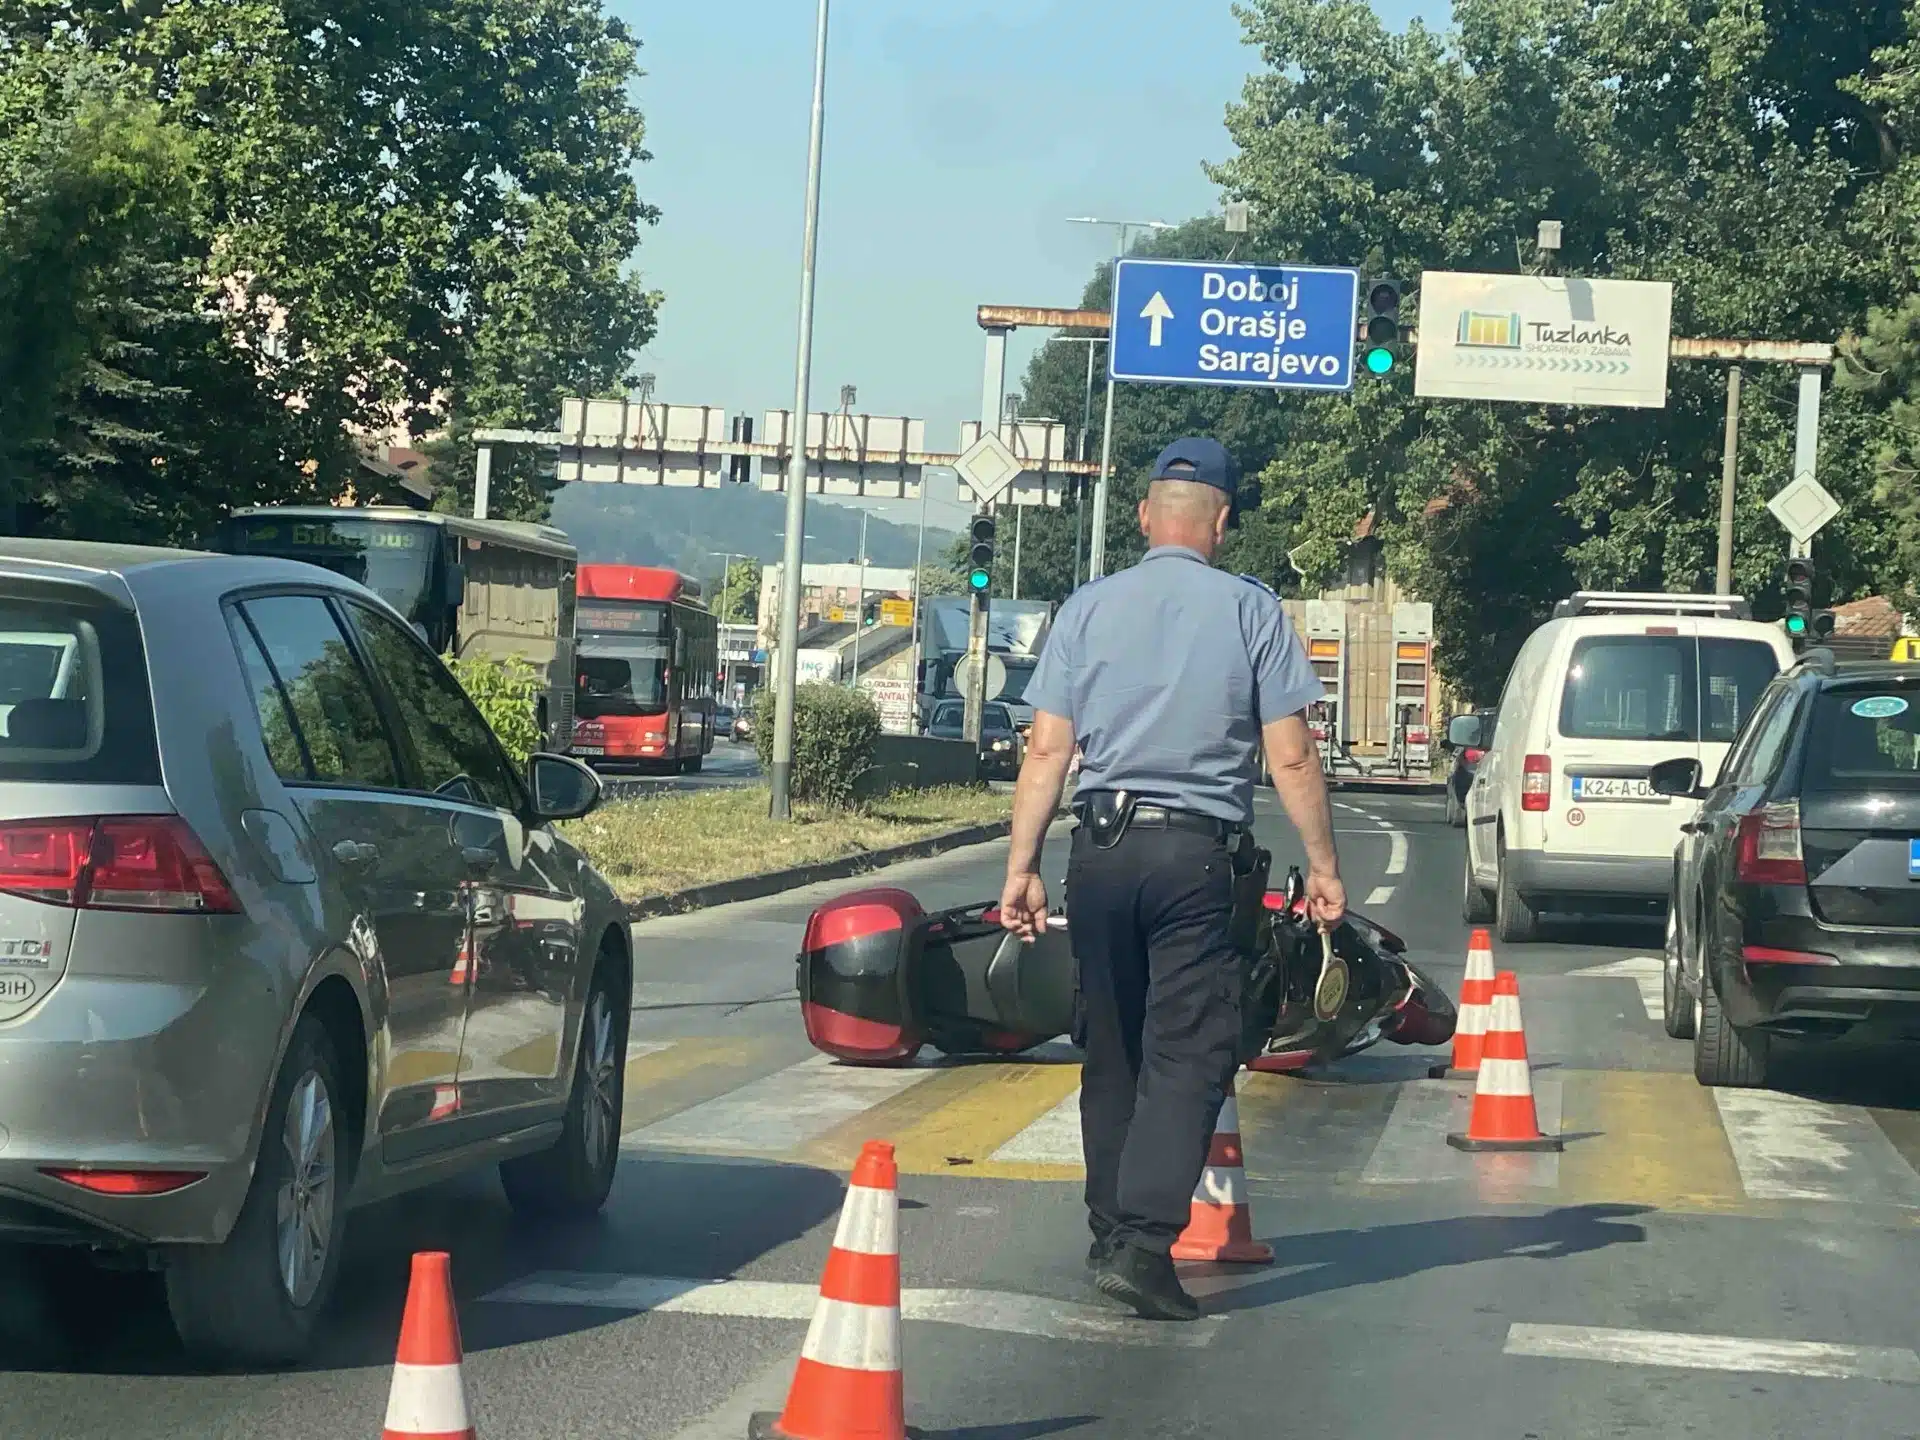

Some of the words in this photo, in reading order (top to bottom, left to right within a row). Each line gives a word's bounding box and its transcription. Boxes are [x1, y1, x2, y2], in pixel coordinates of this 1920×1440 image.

[1202, 271, 1299, 309] Doboj
[1200, 306, 1308, 341] Orašje
[1528, 321, 1631, 346] Tuzlanka
[1198, 344, 1341, 380] Sarajevo
[1525, 343, 1580, 355] SHOPPING
[1590, 346, 1632, 357] ZABAVA
[1584, 779, 1663, 797] K24-A-08
[1, 938, 51, 956] TDI
